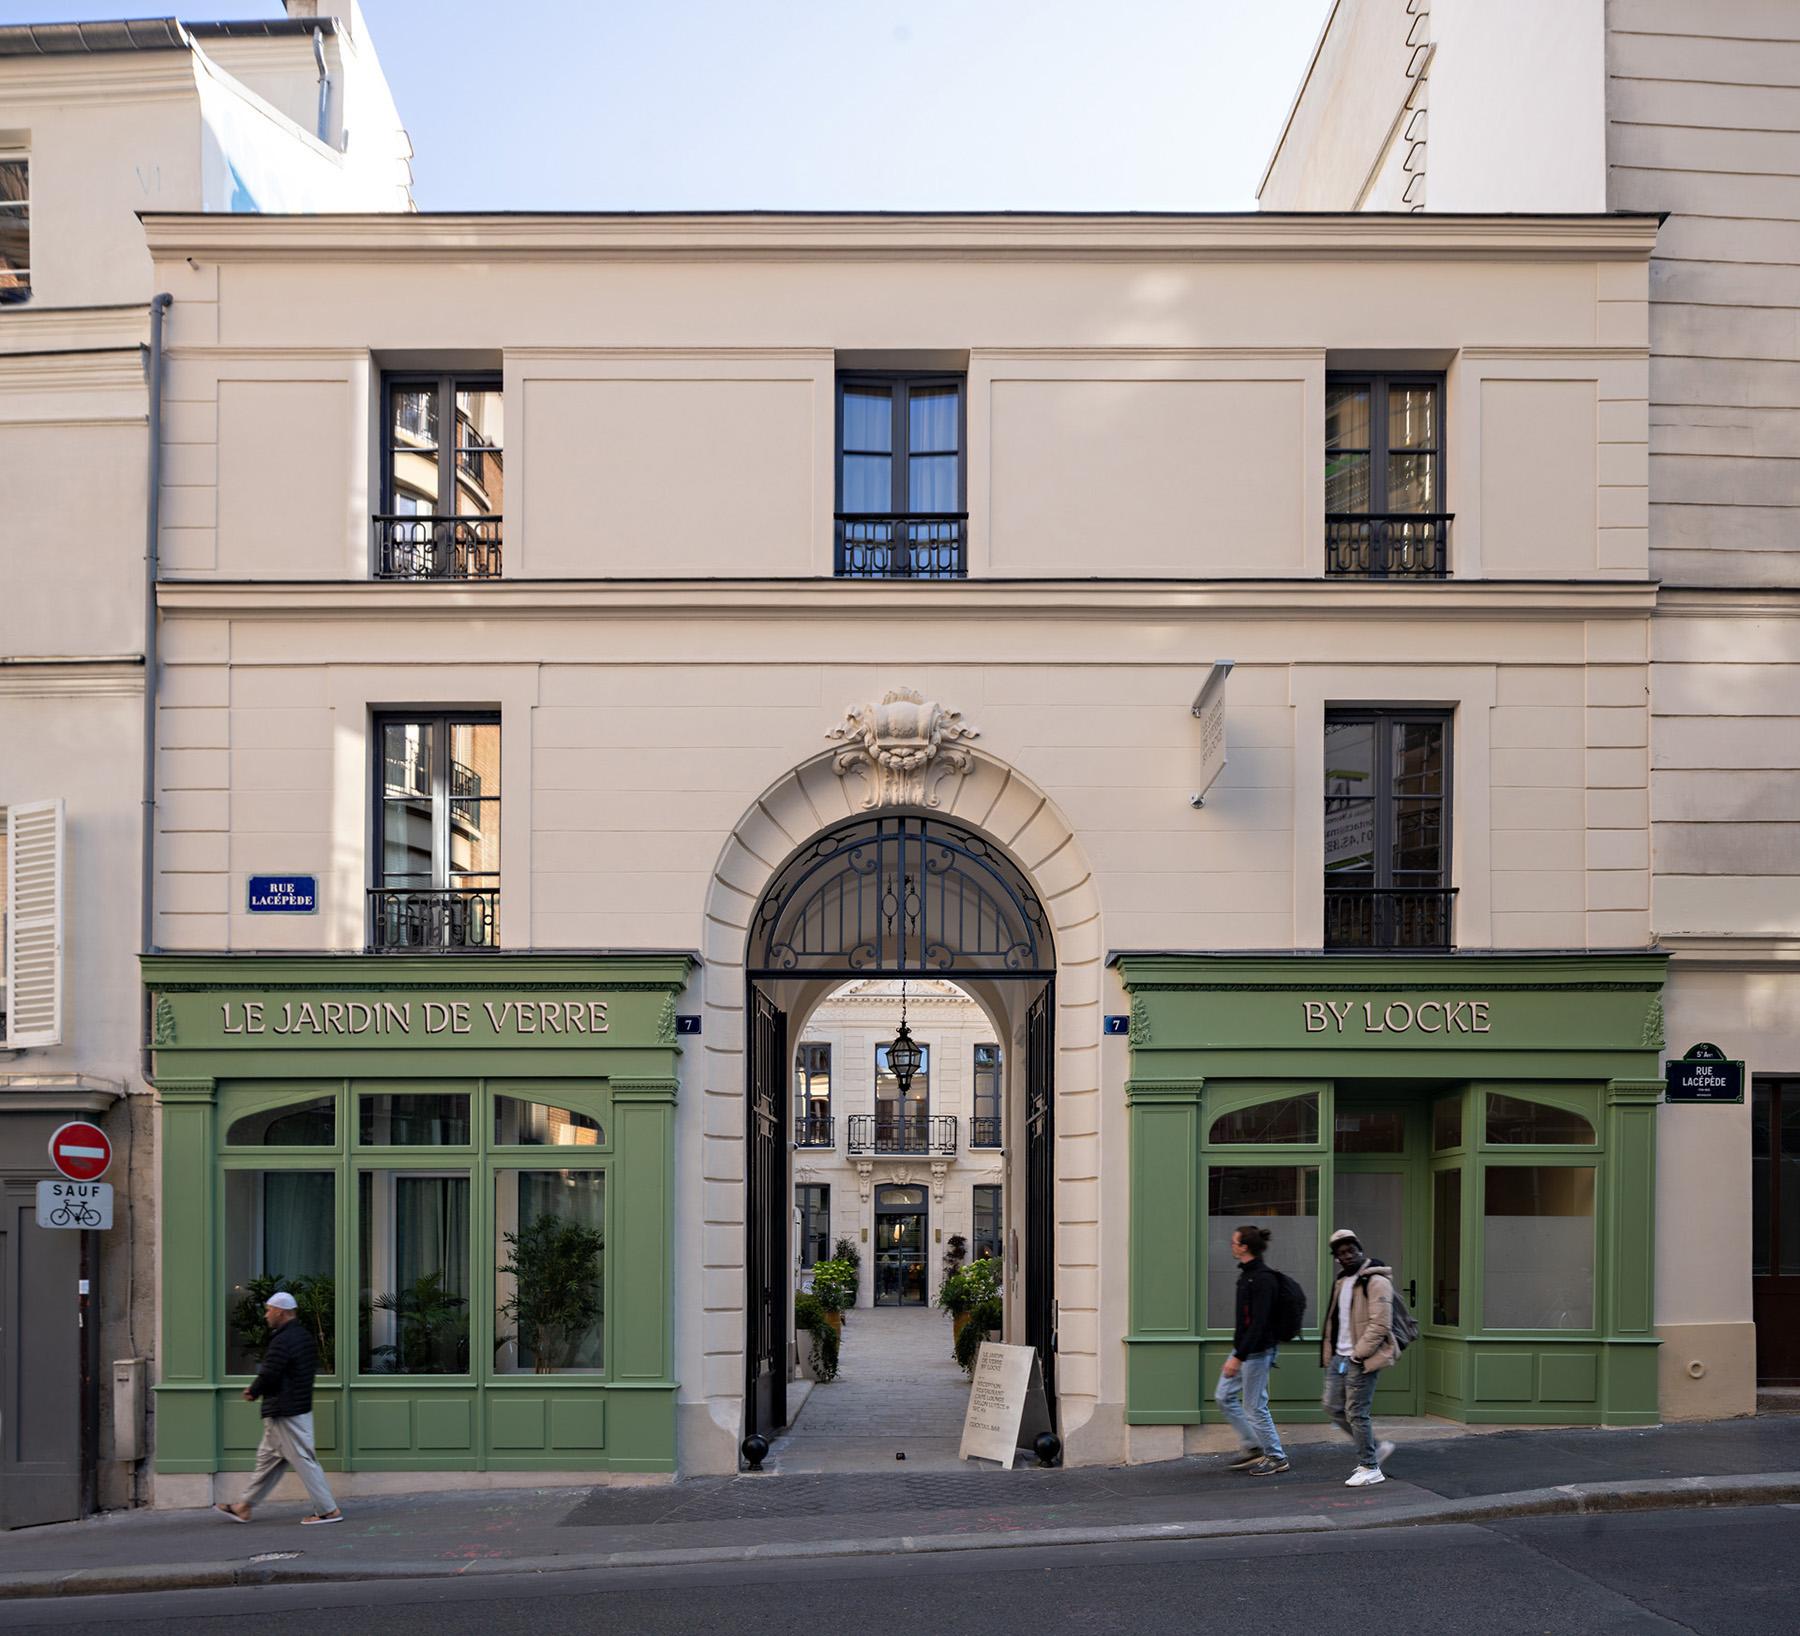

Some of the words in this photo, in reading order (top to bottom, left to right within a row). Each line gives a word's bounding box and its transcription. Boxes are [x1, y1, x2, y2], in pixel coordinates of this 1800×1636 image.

[270, 883, 295, 893] RUE
[251, 892, 313, 905] LACÉPÈDE
[222, 1002, 266, 1034] LE
[273, 1002, 411, 1034] JARDIN
[422, 1002, 472, 1034] DE
[483, 1002, 610, 1034] VERRE
[1302, 1001, 1354, 1034] BY
[1362, 1001, 1492, 1034] LOCKE
[684, 1019, 693, 1031] 7
[1112, 1019, 1121, 1031] 7
[1696, 1066, 1713, 1075] RUE
[1682, 1075, 1726, 1087] LACÉPÈDE
[53, 1184, 100, 1198] SAUF
